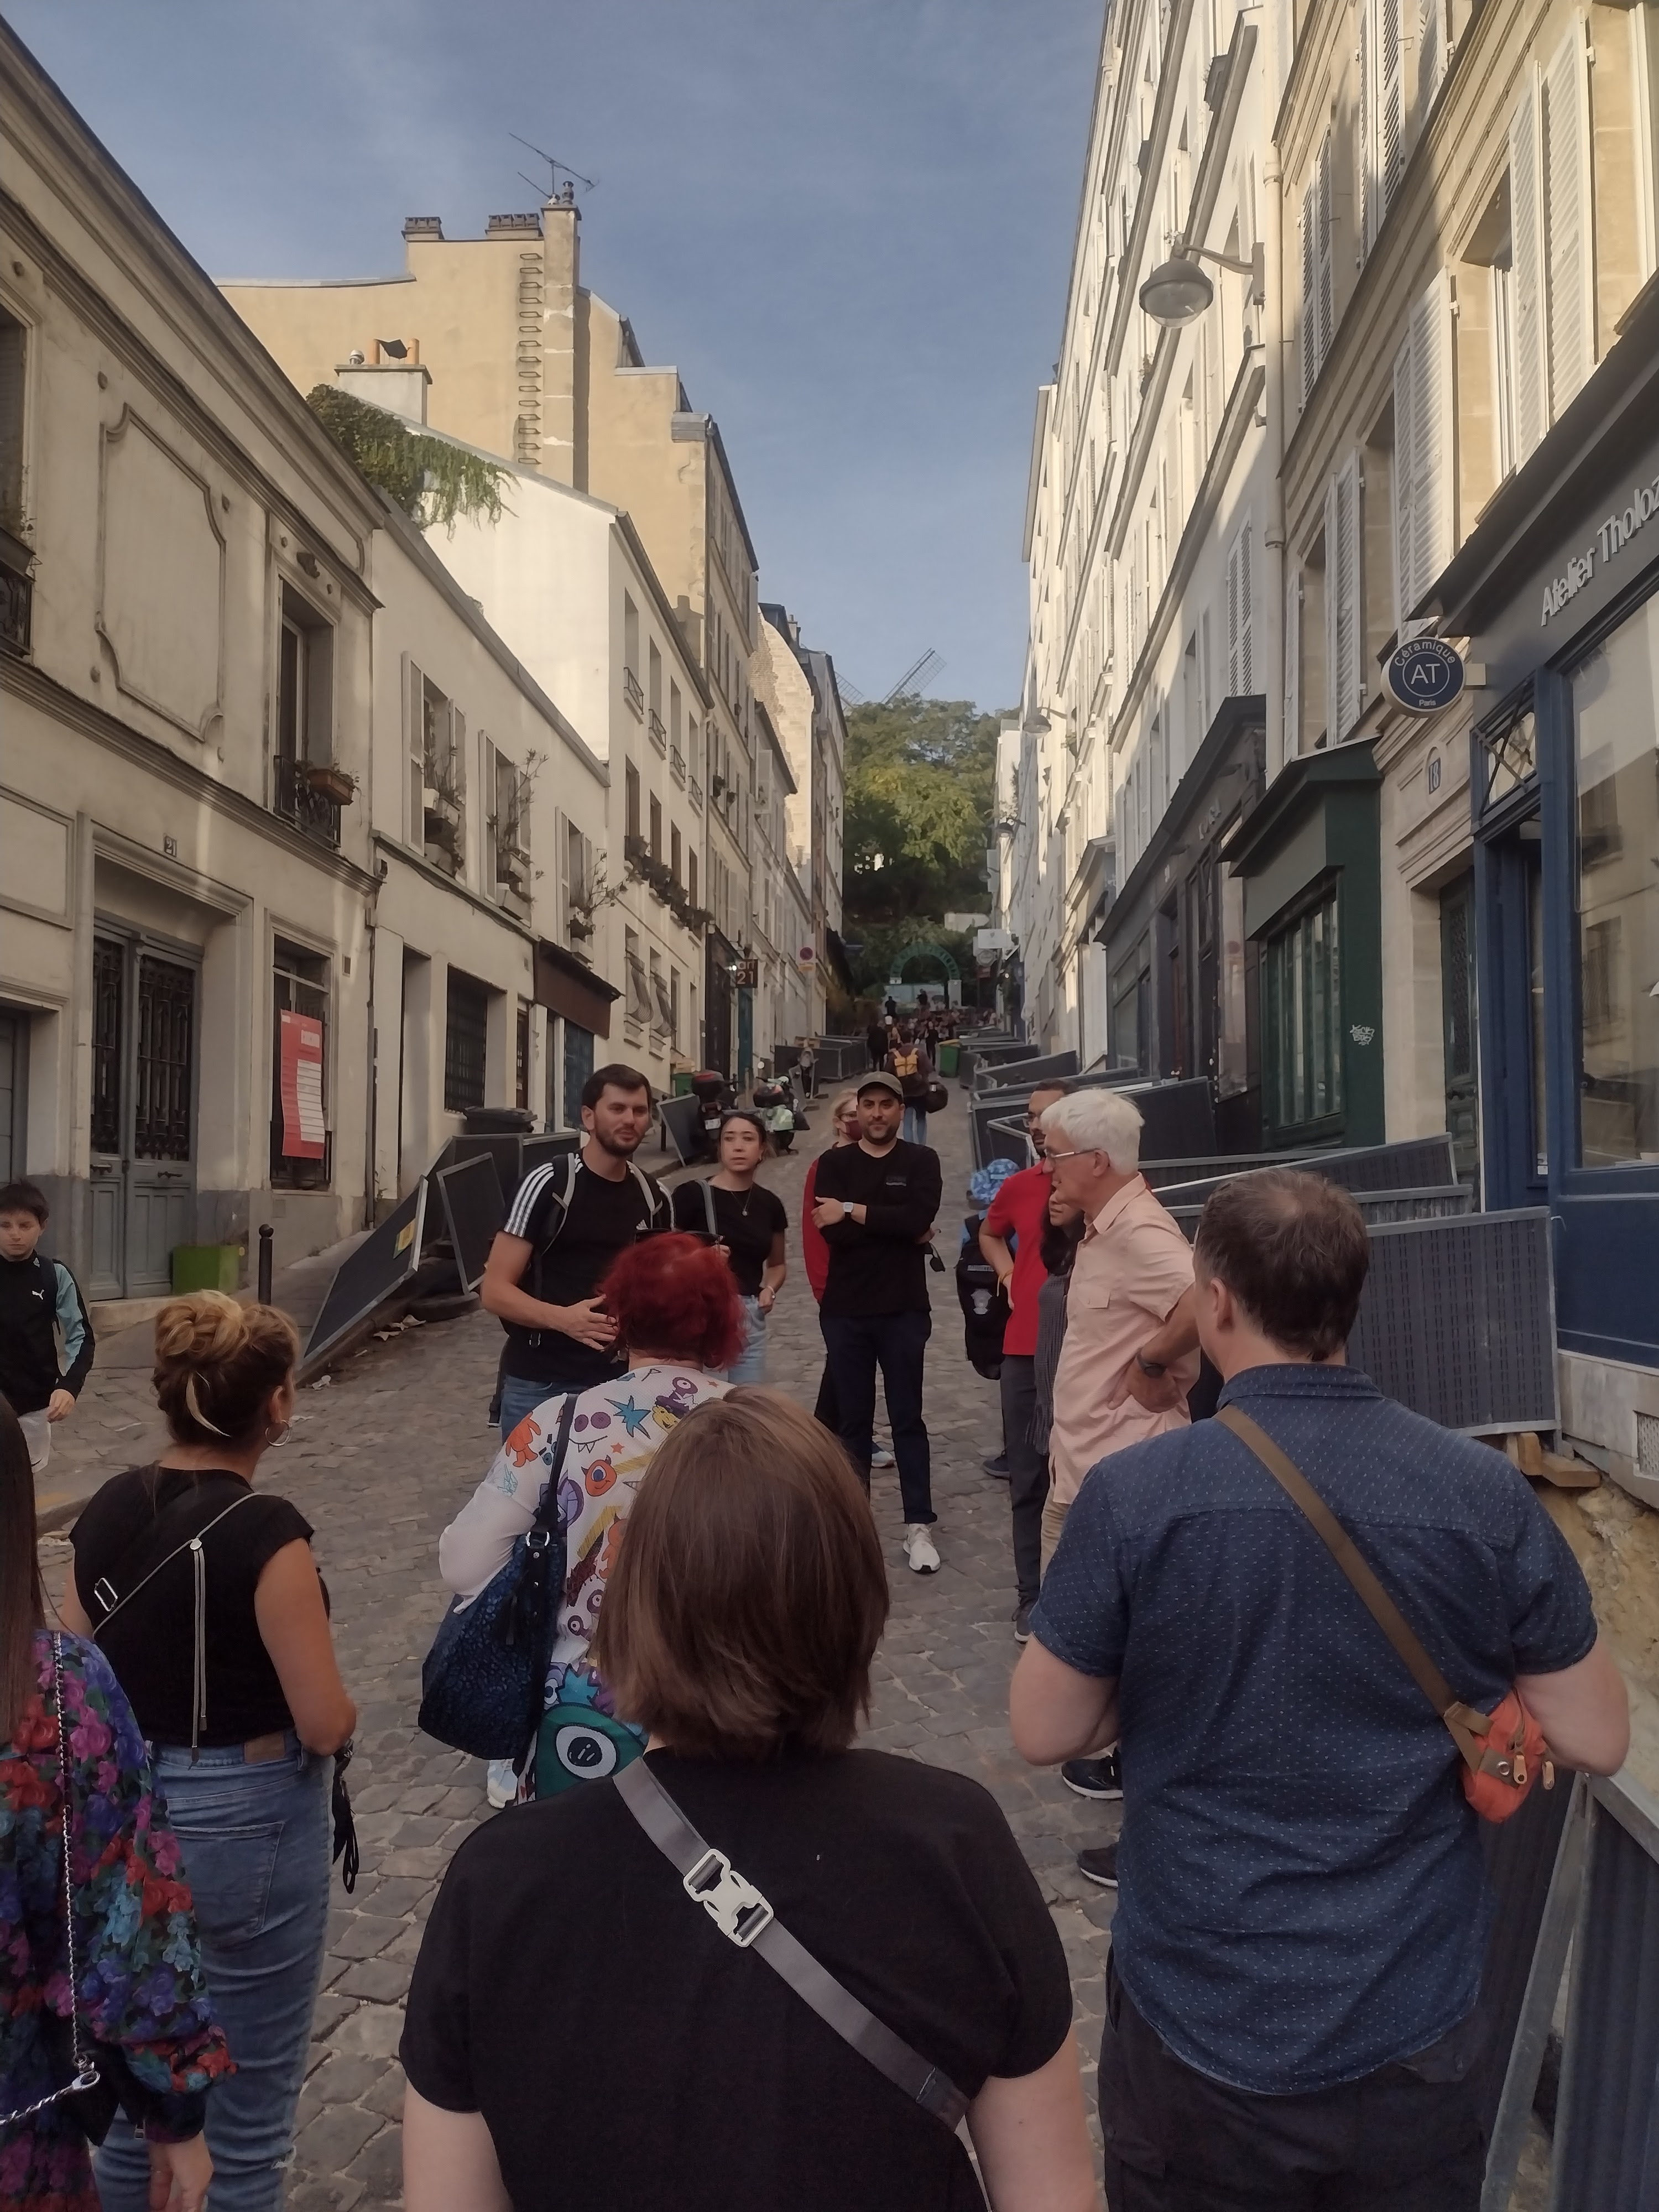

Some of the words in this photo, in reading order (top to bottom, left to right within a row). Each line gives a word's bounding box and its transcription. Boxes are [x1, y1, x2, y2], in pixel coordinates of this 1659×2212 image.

[1541, 547, 1596, 627] Atelier
[1394, 640, 1455, 666] Céramique
[1411, 663, 1441, 685] AT
[1418, 698, 1437, 707] Paris
[1430, 760, 1439, 792] 18
[165, 836, 176, 857] 21
[737, 971, 754, 984] 21
